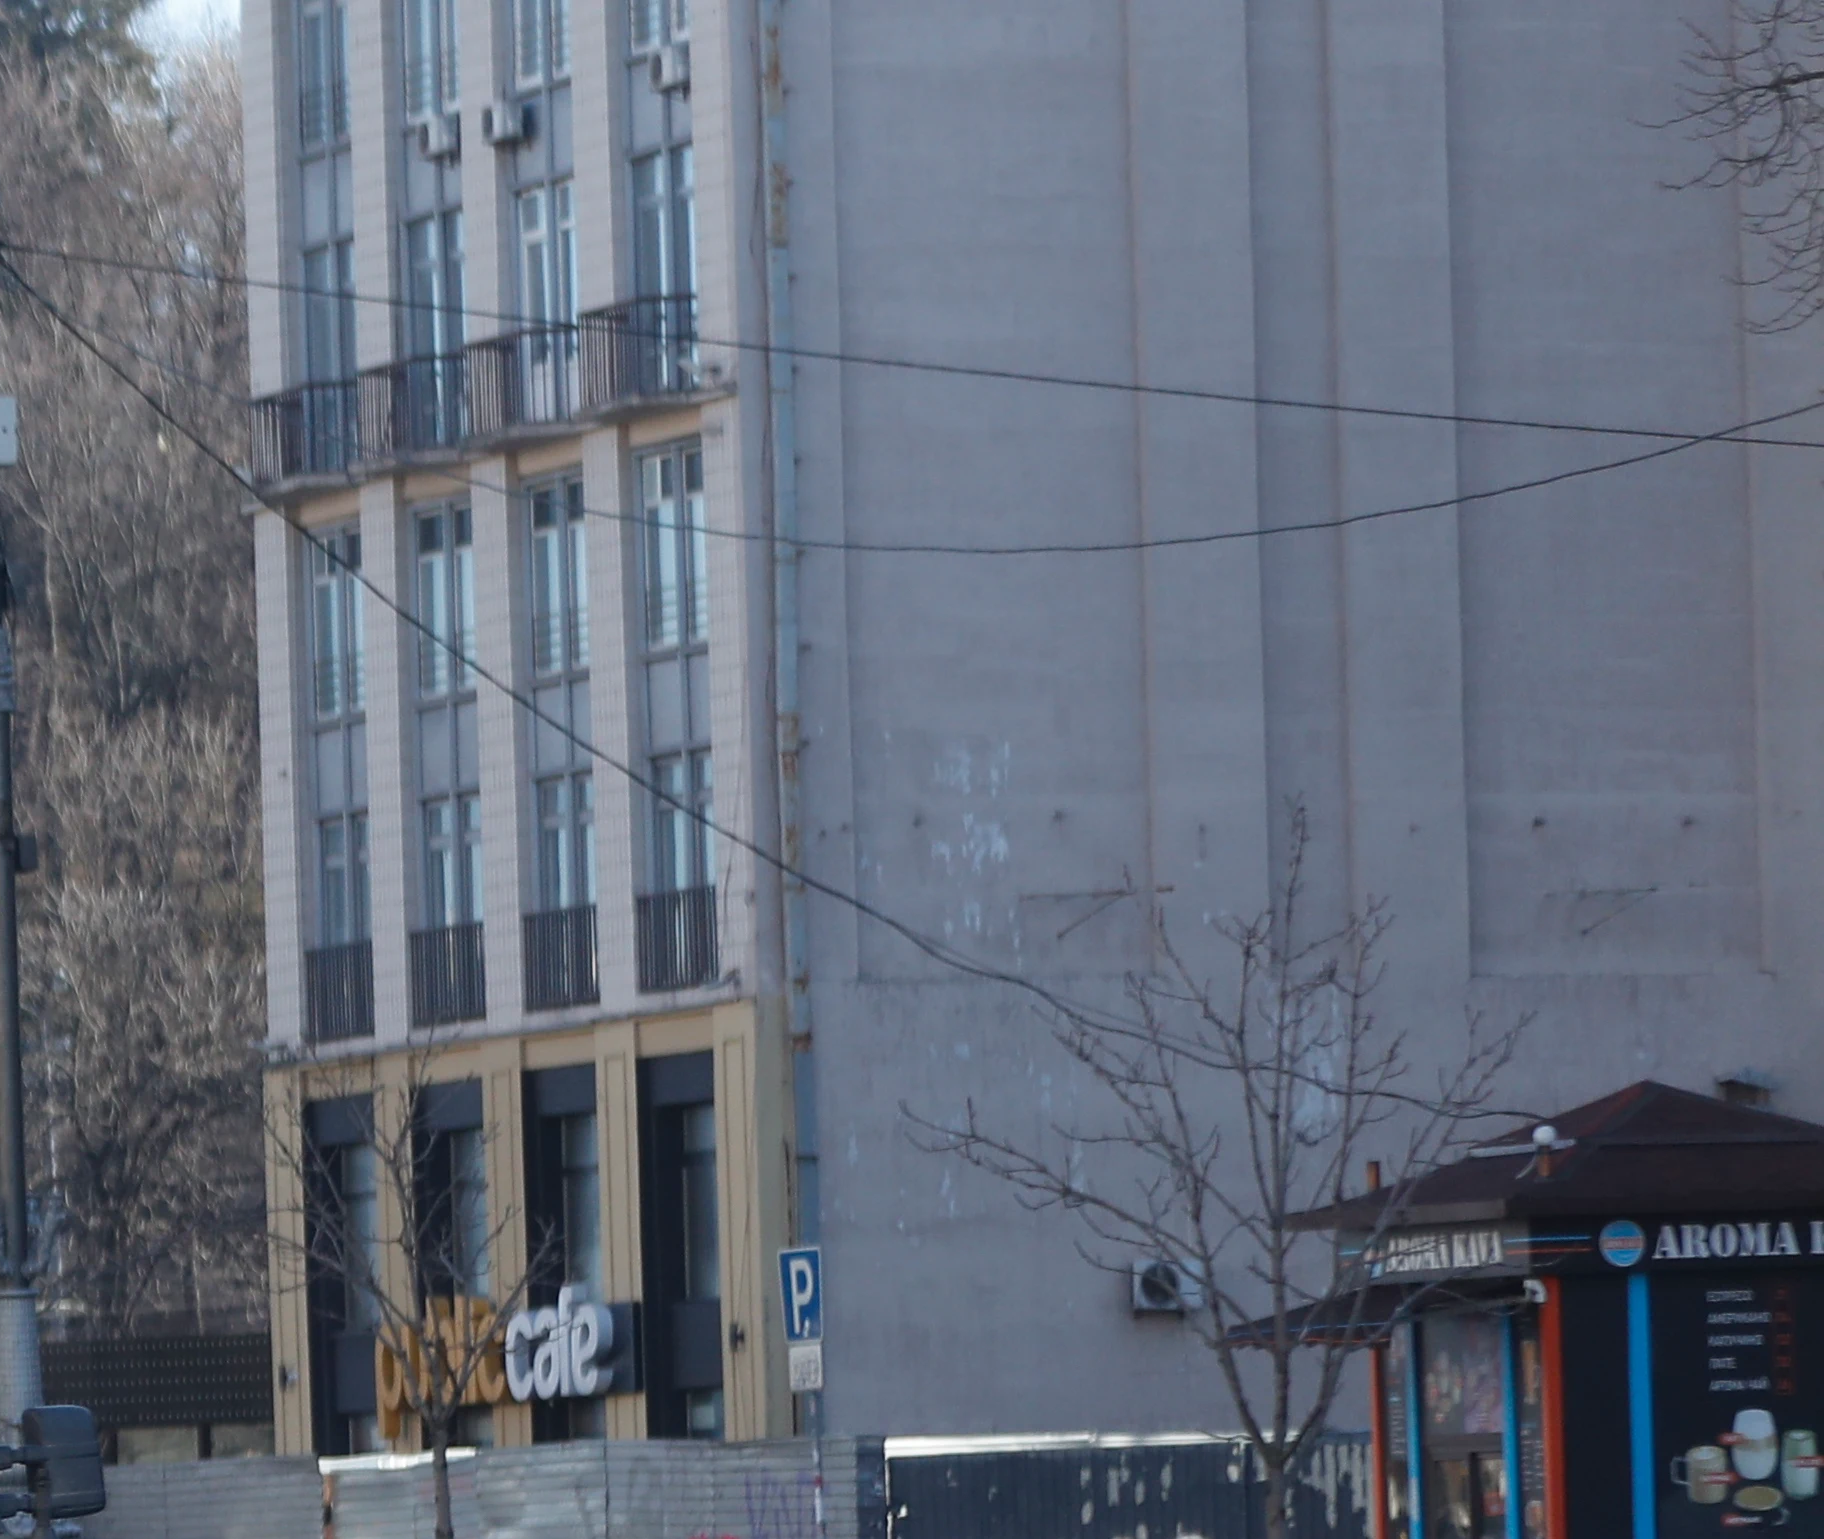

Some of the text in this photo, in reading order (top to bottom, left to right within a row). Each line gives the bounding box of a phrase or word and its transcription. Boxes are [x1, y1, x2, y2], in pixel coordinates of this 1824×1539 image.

[1453, 1230, 1503, 1268] KAVA
[1652, 1221, 1801, 1259] AROMA
[789, 1258, 814, 1335] P
